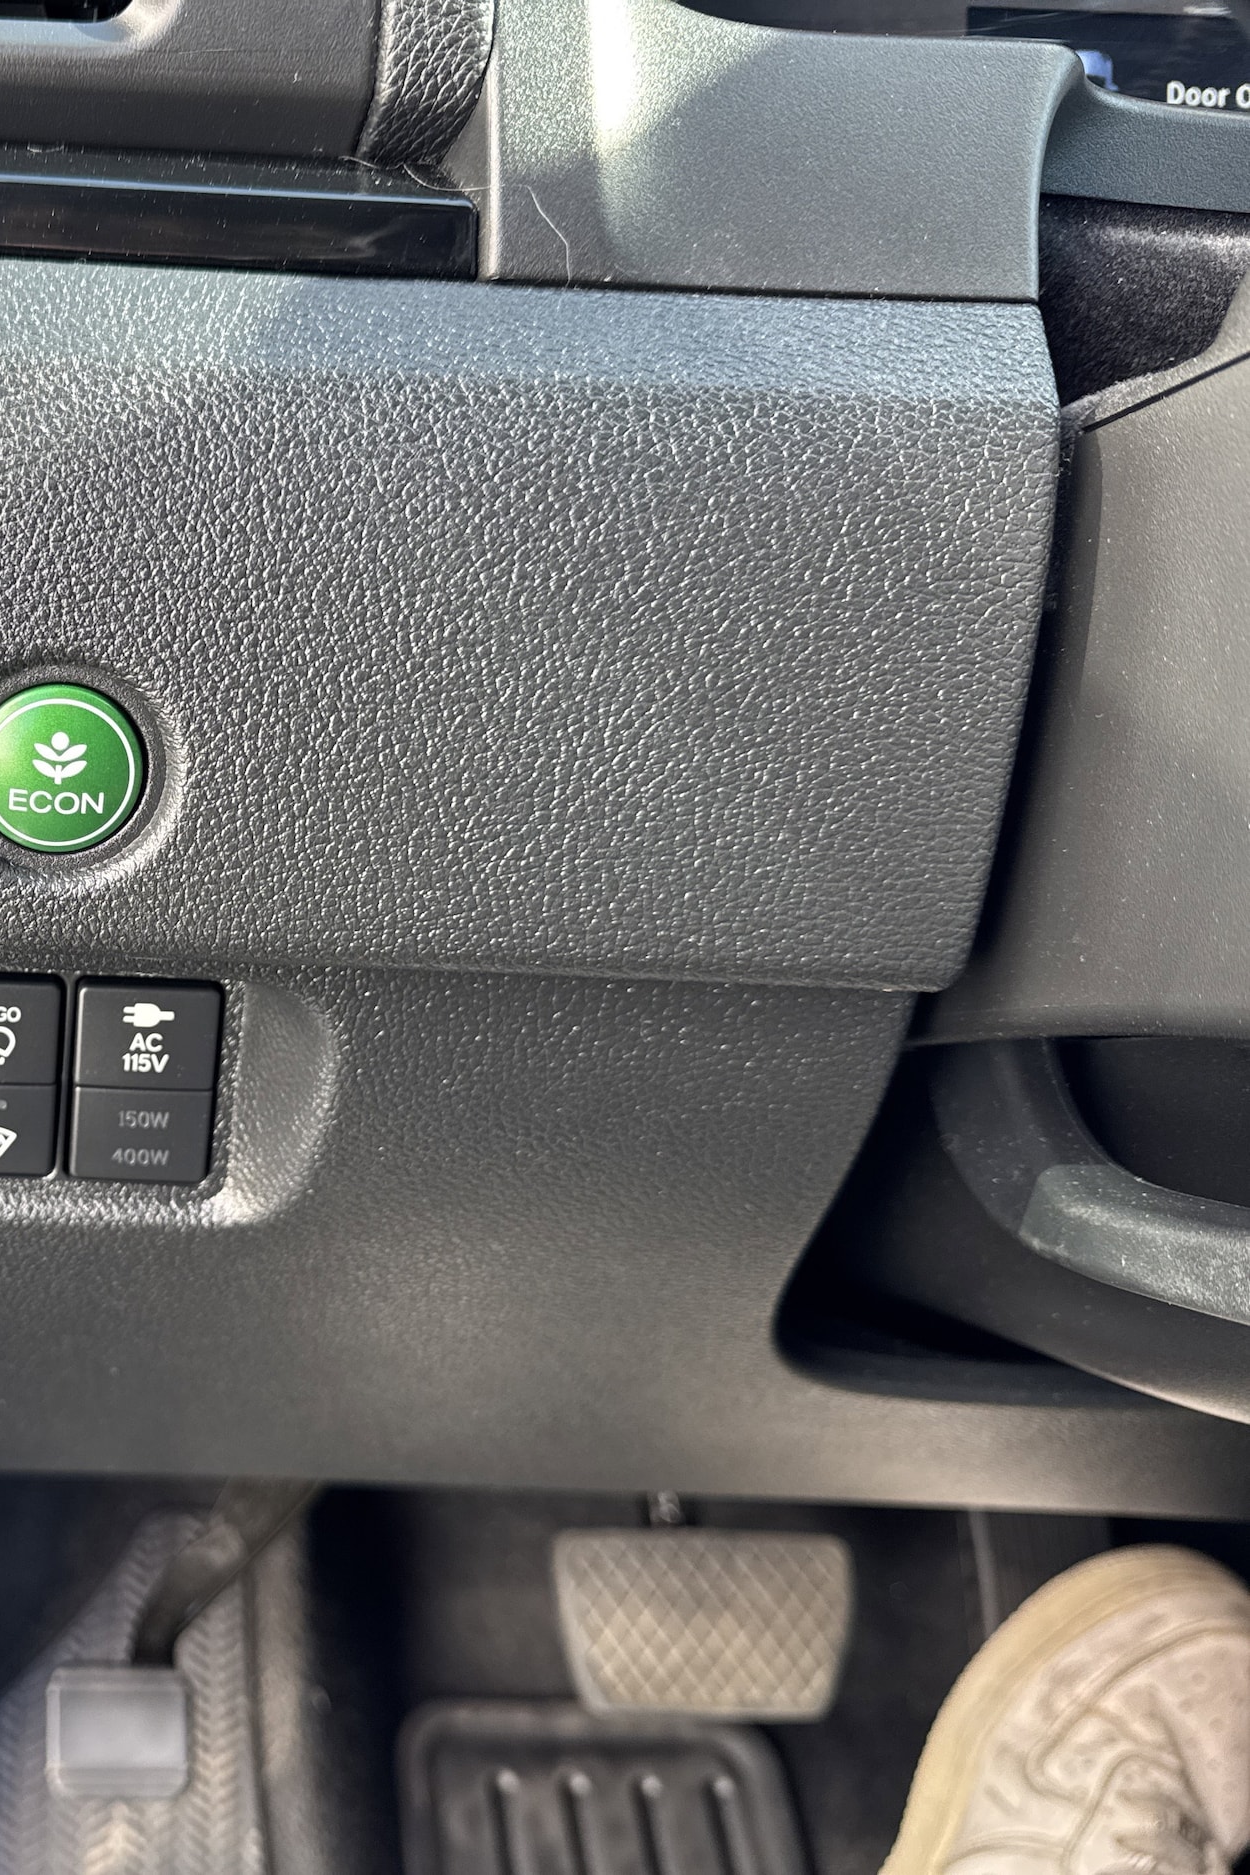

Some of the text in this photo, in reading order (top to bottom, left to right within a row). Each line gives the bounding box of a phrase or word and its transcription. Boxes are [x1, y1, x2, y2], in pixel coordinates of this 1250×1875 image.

[1166, 80, 1231, 108] Door
[7, 788, 106, 817] ECON
[128, 1033, 163, 1052] AC
[121, 1053, 170, 1074] 115V
[118, 1110, 170, 1130] 150W
[111, 1147, 170, 1167] 400W
